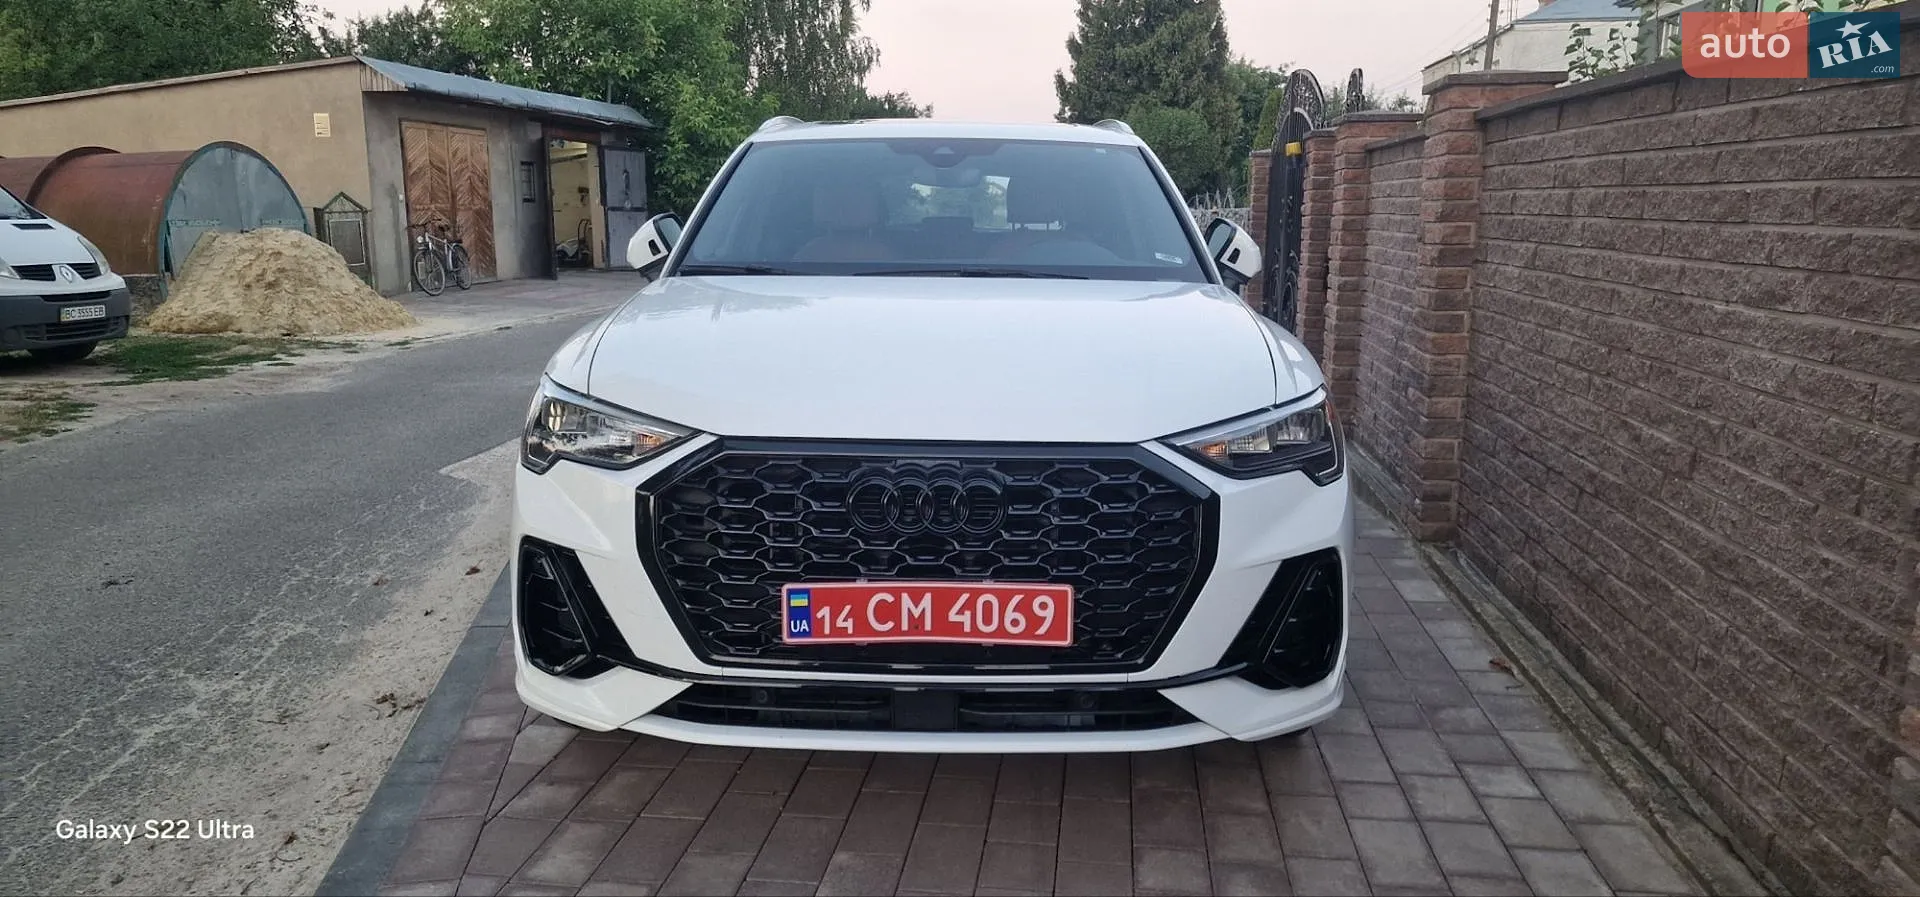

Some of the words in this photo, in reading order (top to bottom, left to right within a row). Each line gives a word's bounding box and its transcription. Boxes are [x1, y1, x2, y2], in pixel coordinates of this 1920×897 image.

[790, 619, 809, 633] UA
[815, 605, 853, 635] 14
[866, 592, 932, 632] CM
[948, 592, 1055, 635] 4069
